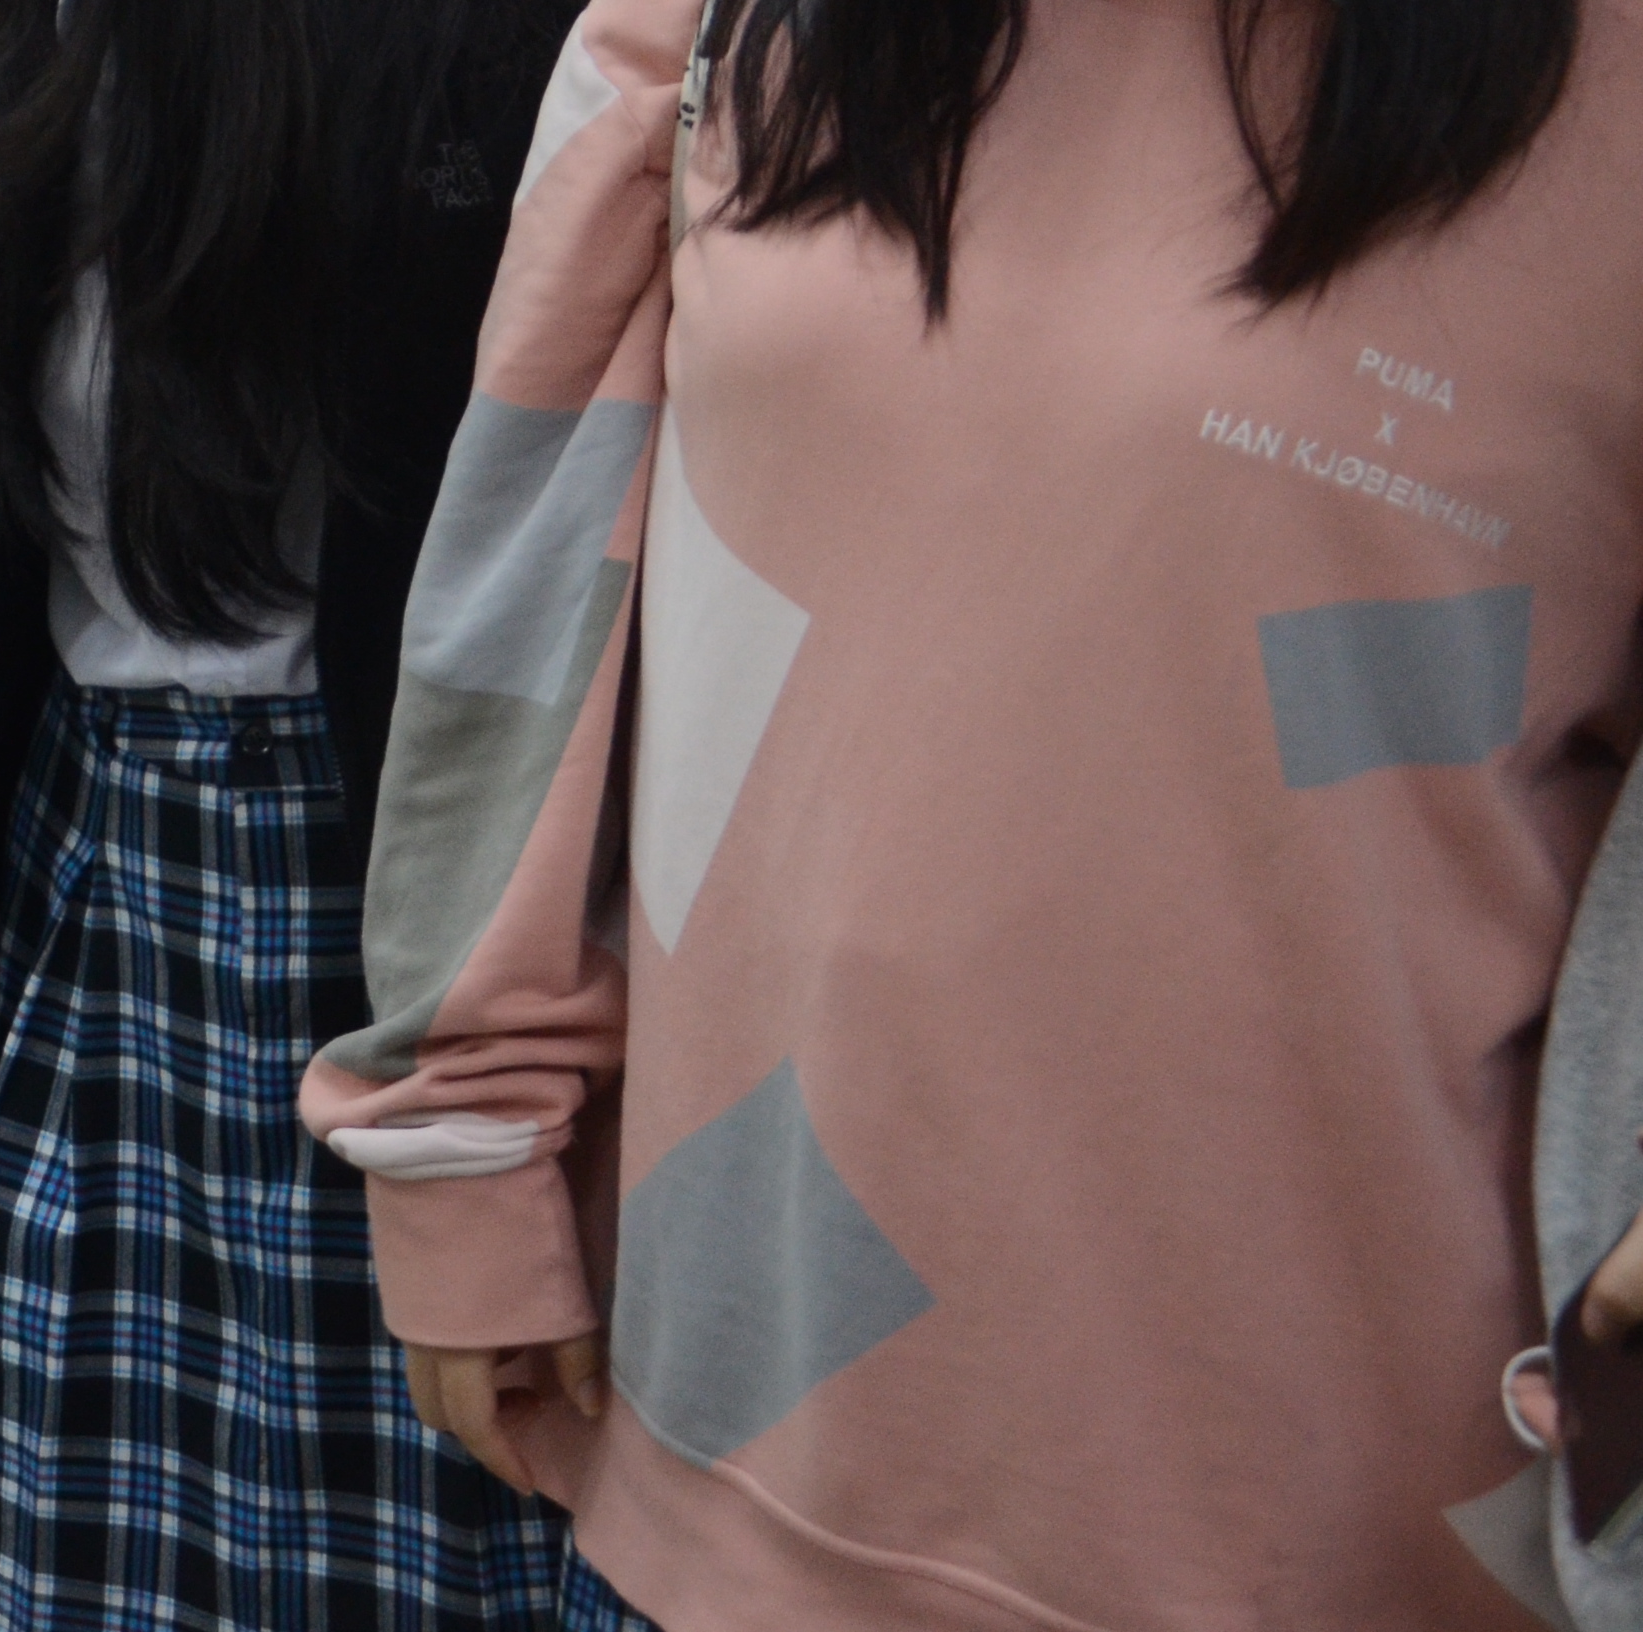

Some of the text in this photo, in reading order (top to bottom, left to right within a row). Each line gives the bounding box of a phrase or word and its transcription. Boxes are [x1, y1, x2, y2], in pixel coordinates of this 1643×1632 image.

[1354, 346, 1455, 412] PUMA
[1199, 408, 1514, 550] HAN KJØBENHAVN
